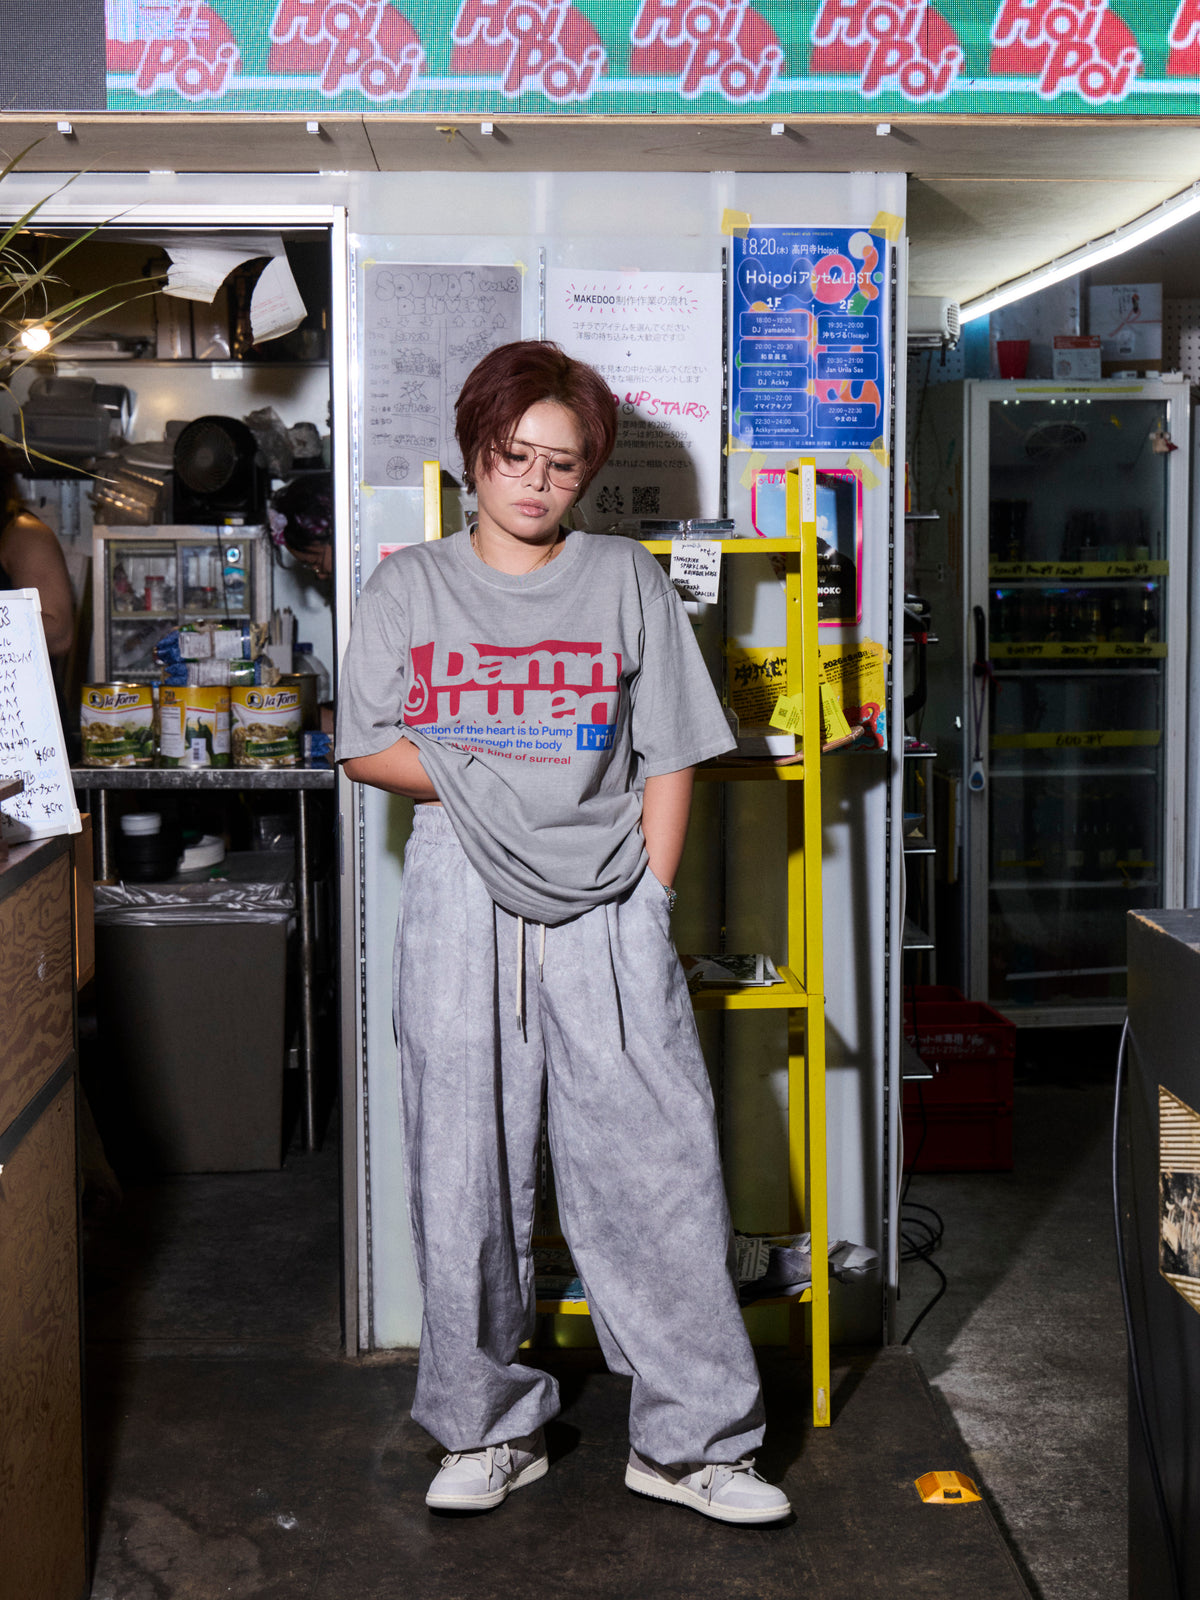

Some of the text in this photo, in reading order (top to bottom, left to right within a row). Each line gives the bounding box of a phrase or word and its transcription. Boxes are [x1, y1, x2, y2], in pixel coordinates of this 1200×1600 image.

[766, 297, 782, 308] 1F
[839, 300, 855, 310] 2F
[431, 641, 618, 688] Damn
[453, 725, 465, 735] of
[467, 726, 485, 735] the
[486, 726, 515, 735] heart
[517, 726, 527, 735] is
[529, 727, 541, 736] to
[542, 727, 574, 738] Pump
[515, 739, 533, 749] the
[535, 740, 563, 752] body
[461, 744, 484, 753] was
[487, 748, 511, 759] kind
[514, 754, 528, 762] of
[529, 756, 572, 765] surreal
